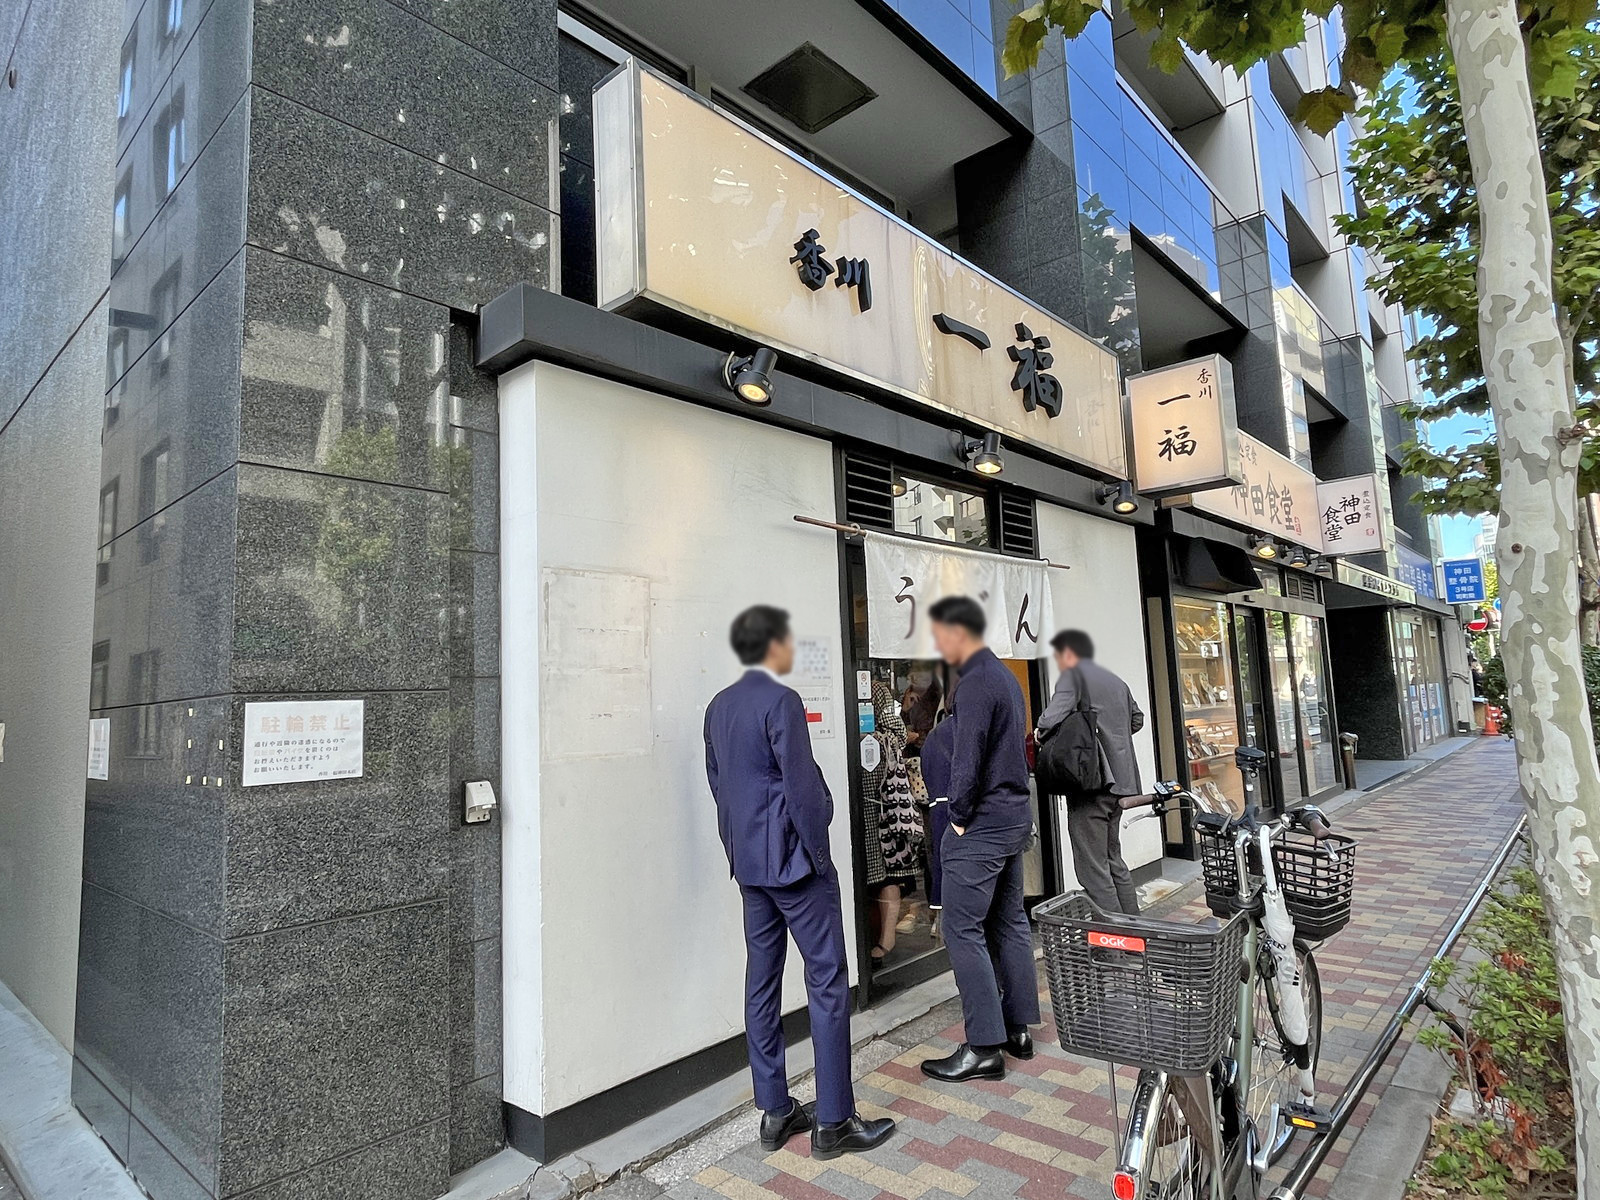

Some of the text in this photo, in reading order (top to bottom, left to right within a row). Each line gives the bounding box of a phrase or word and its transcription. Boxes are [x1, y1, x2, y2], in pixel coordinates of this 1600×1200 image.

[790, 228, 1063, 419] 香川 一福
[1196, 368, 1212, 399] 香川
[1157, 393, 1197, 462] 一福
[1230, 462, 1296, 531] 神田食堂
[1339, 494, 1361, 525] 神田
[1322, 505, 1343, 542] 食堂
[1448, 575, 1479, 585] 整骨院
[1453, 567, 1472, 575] 神田
[260, 714, 352, 734] 駐輪禁止
[1099, 936, 1126, 948] OGK
